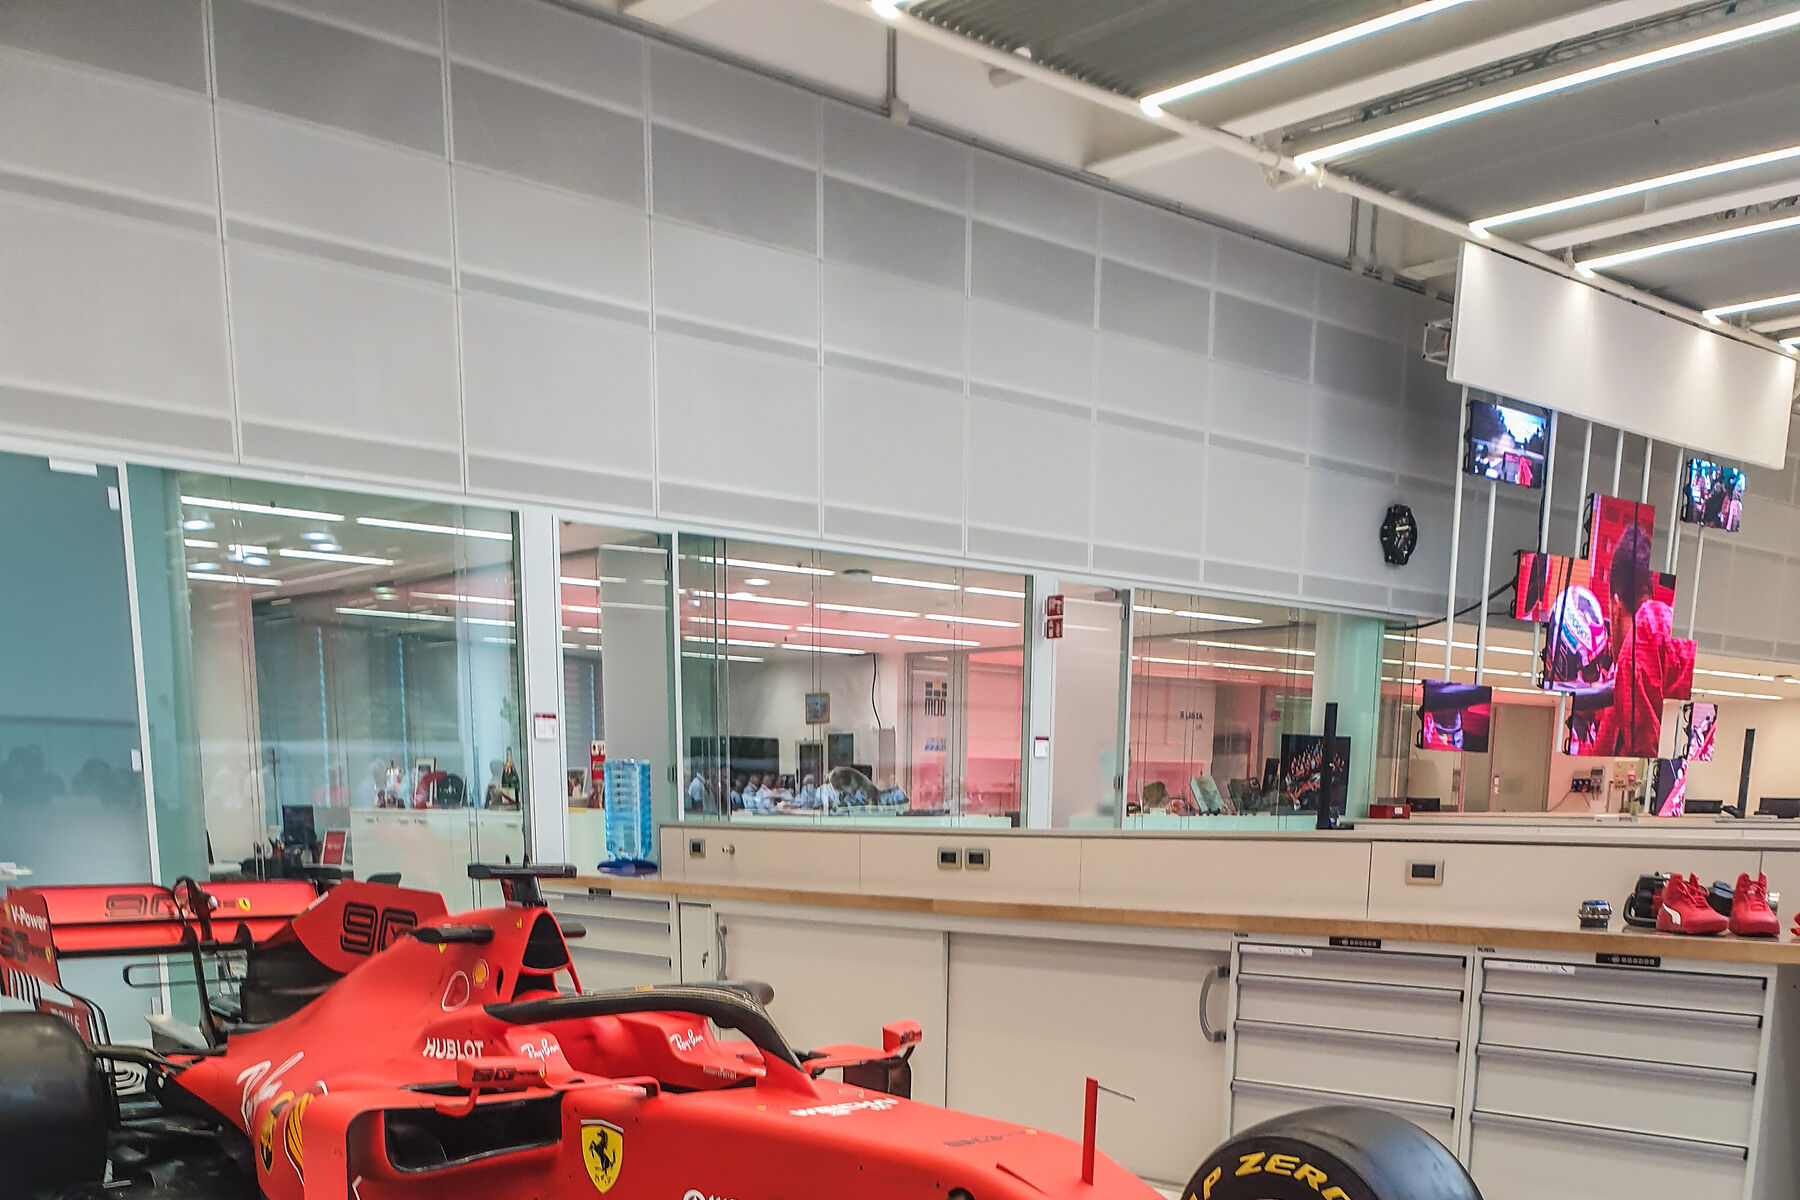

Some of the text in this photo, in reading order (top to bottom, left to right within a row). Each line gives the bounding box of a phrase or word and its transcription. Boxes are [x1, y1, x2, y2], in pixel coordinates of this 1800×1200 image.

[10, 904, 48, 932] V-Power
[422, 1037, 484, 1060] HUBLOT
[1203, 1166, 1222, 1200] P
